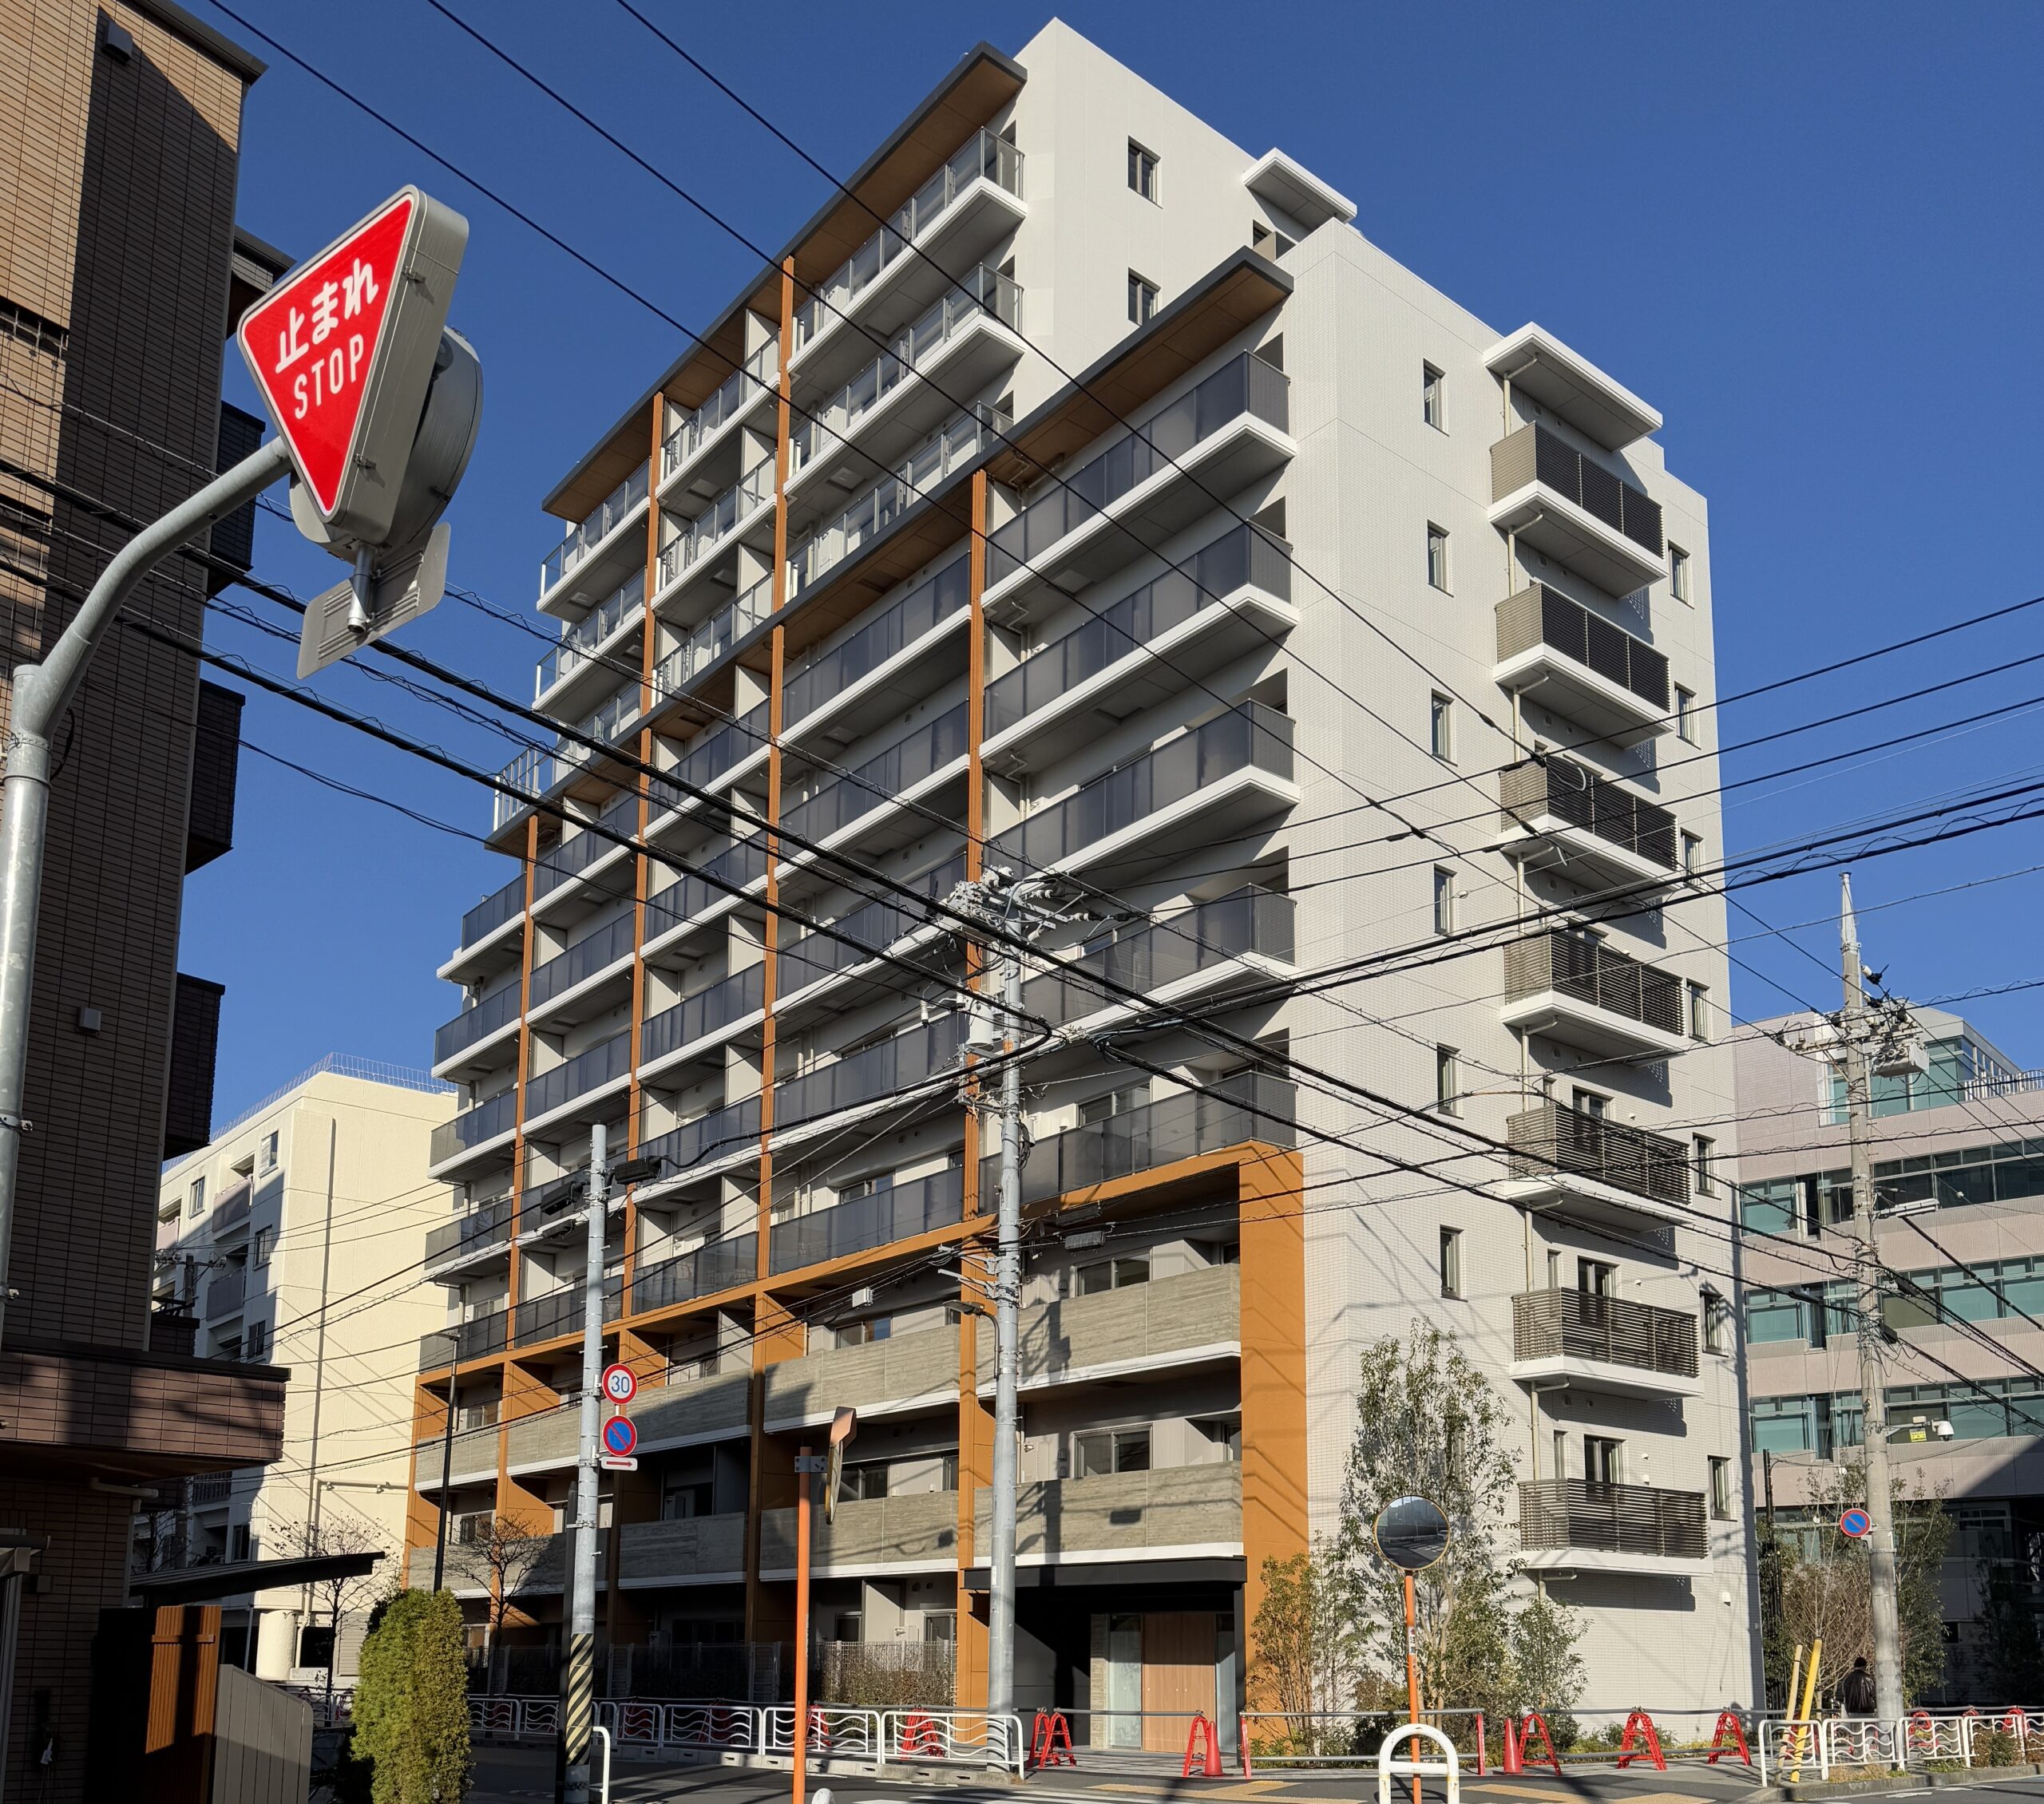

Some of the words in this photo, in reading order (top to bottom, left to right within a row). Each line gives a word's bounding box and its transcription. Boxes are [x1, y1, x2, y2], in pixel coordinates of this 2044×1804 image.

[275, 258, 379, 374] 止まれ
[294, 334, 364, 420] STOP
[611, 1375, 630, 1394] 30
